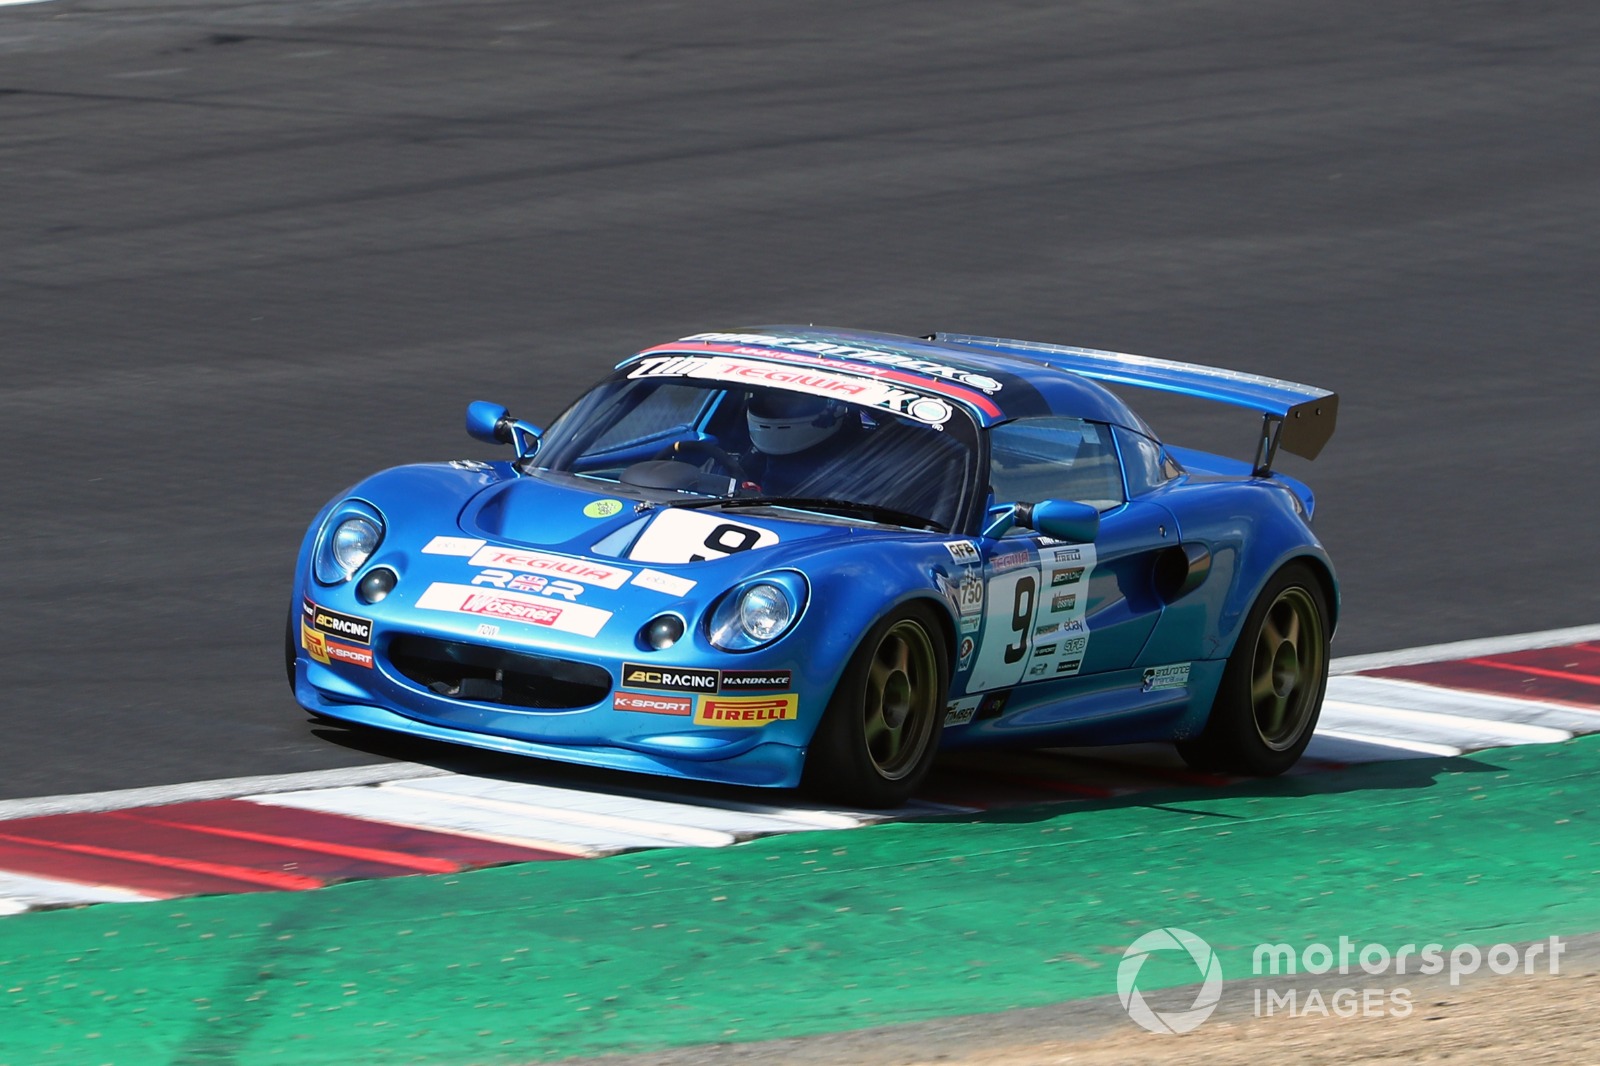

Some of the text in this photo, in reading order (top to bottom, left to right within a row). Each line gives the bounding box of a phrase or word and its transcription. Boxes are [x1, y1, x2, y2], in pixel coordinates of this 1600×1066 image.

[716, 363, 865, 396] TEGIWA
[1053, 548, 1081, 563] PIRELLI
[489, 551, 613, 582] TEGIWA
[961, 583, 983, 605] 750
[1003, 575, 1036, 665] 9
[481, 625, 497, 636] TOW
[327, 645, 373, 664] K-SPORT
[723, 676, 790, 685] HARDRACE
[614, 697, 690, 711] K-SPORT
[703, 699, 788, 720] PIRELLI
